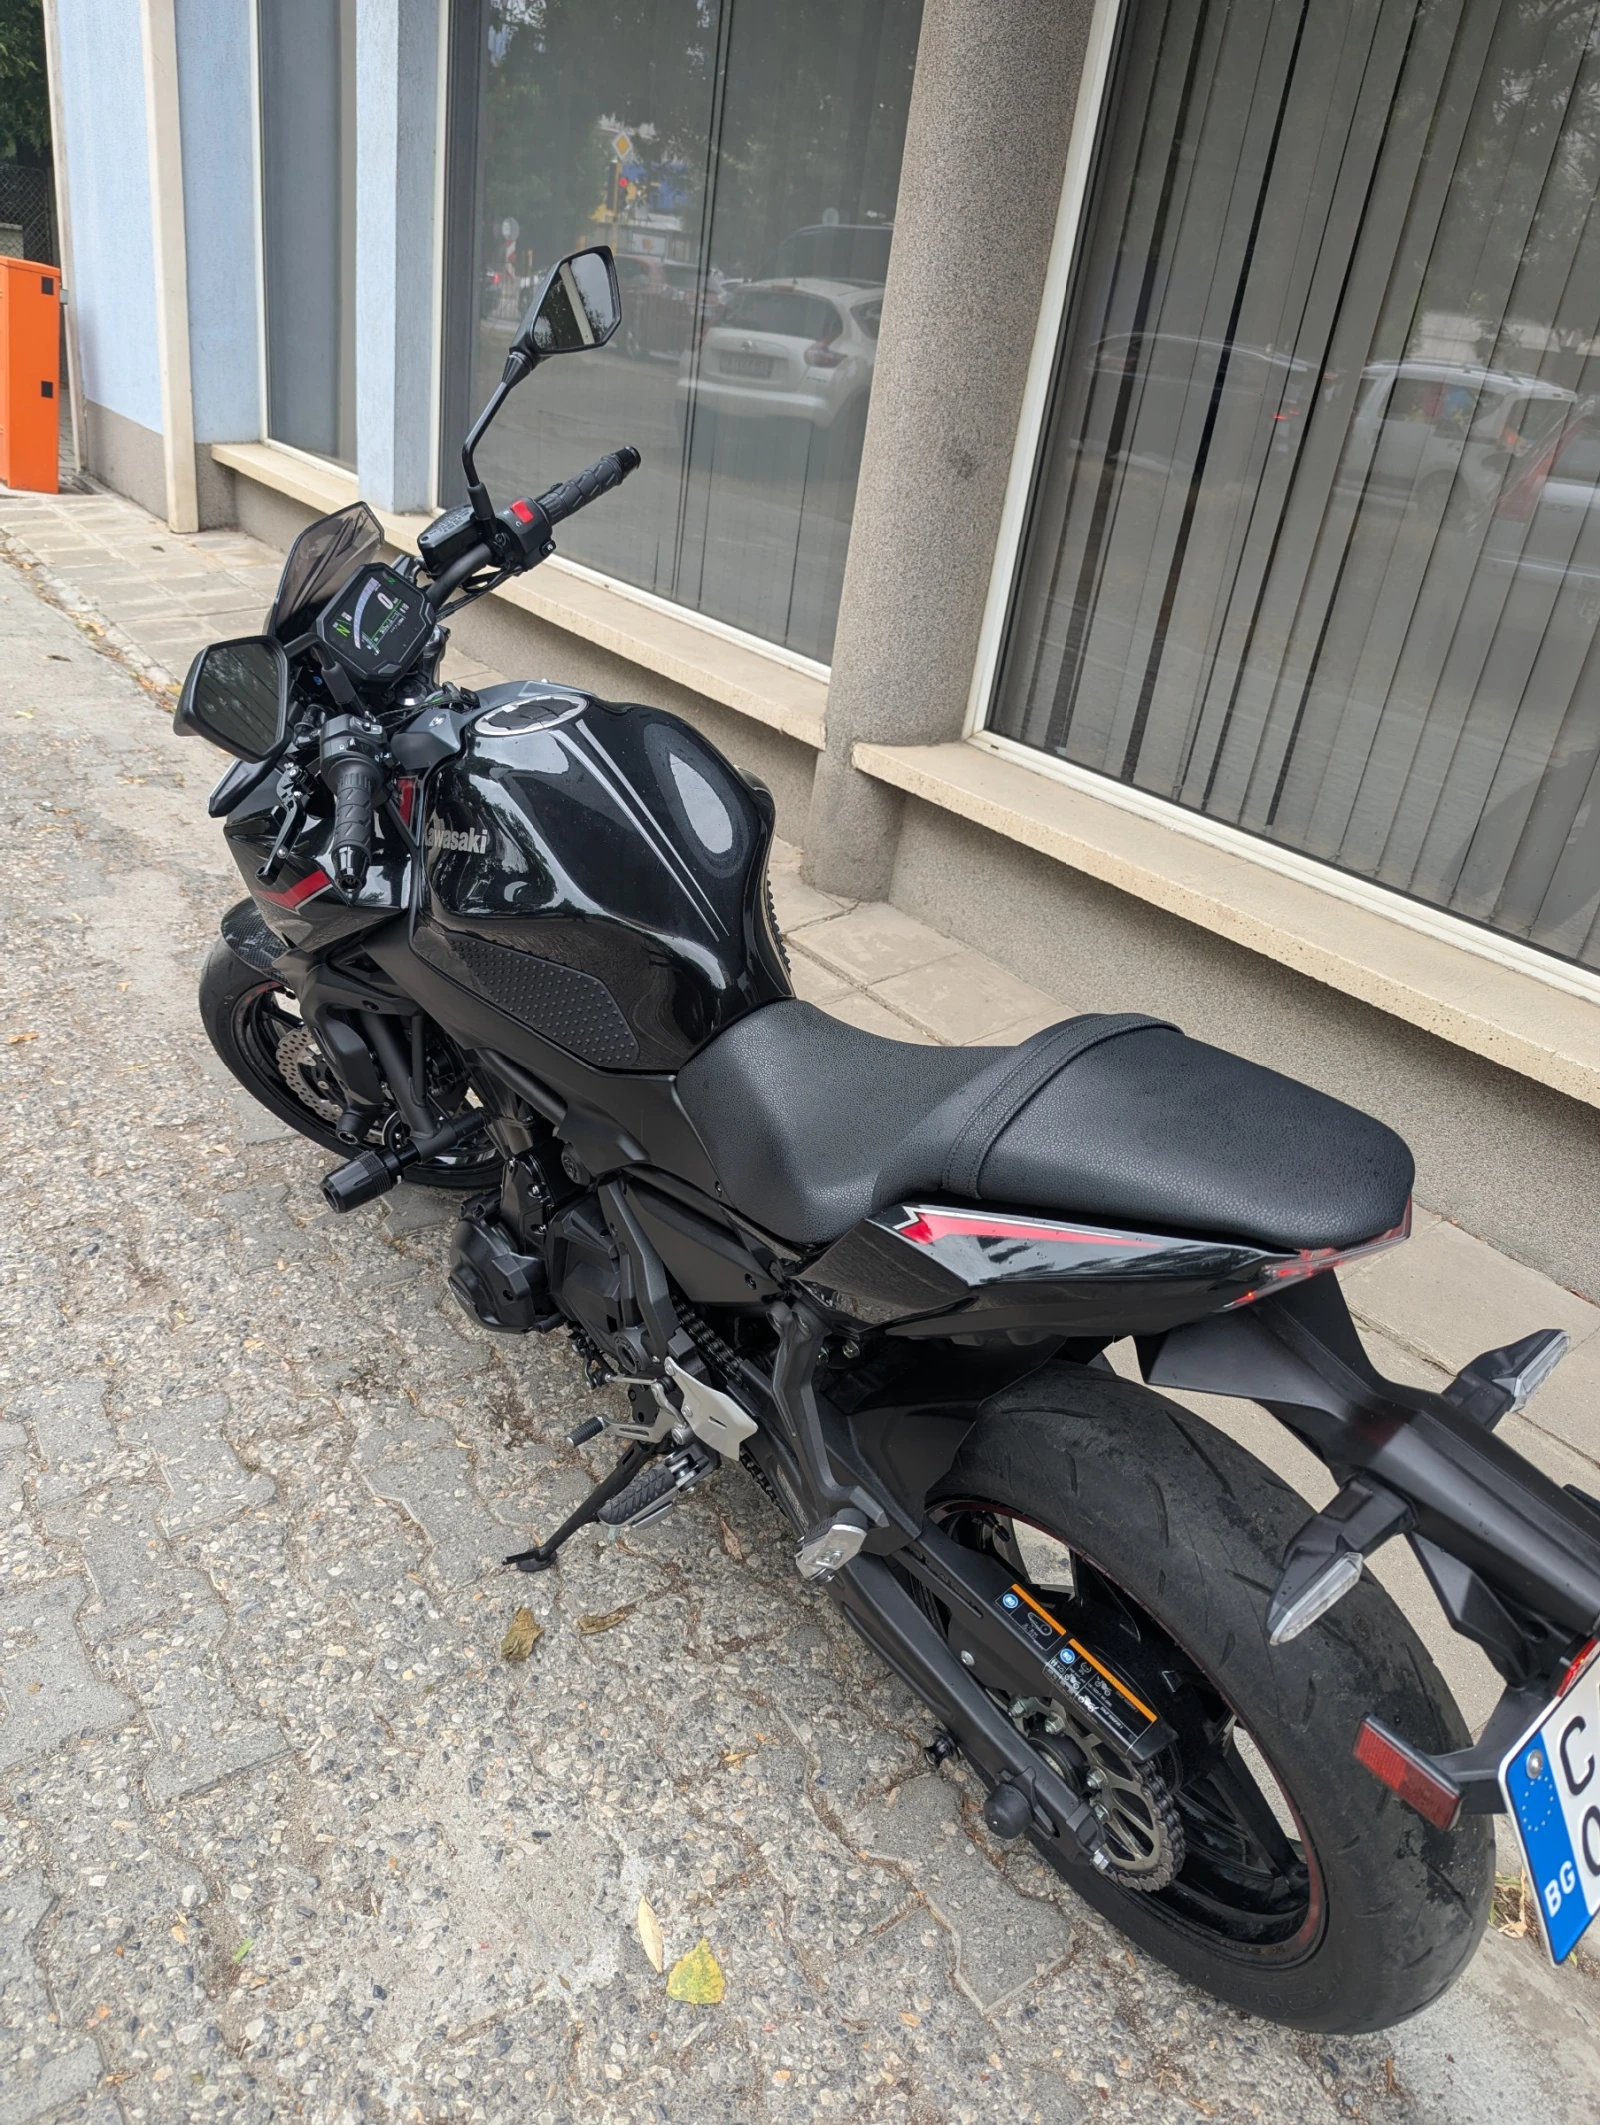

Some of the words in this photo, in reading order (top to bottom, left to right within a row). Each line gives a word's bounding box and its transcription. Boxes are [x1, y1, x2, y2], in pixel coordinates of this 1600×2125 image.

[425, 827, 488, 855] awasaki
[1559, 1690, 1600, 1796] C
[1543, 1859, 1577, 1918] BG
